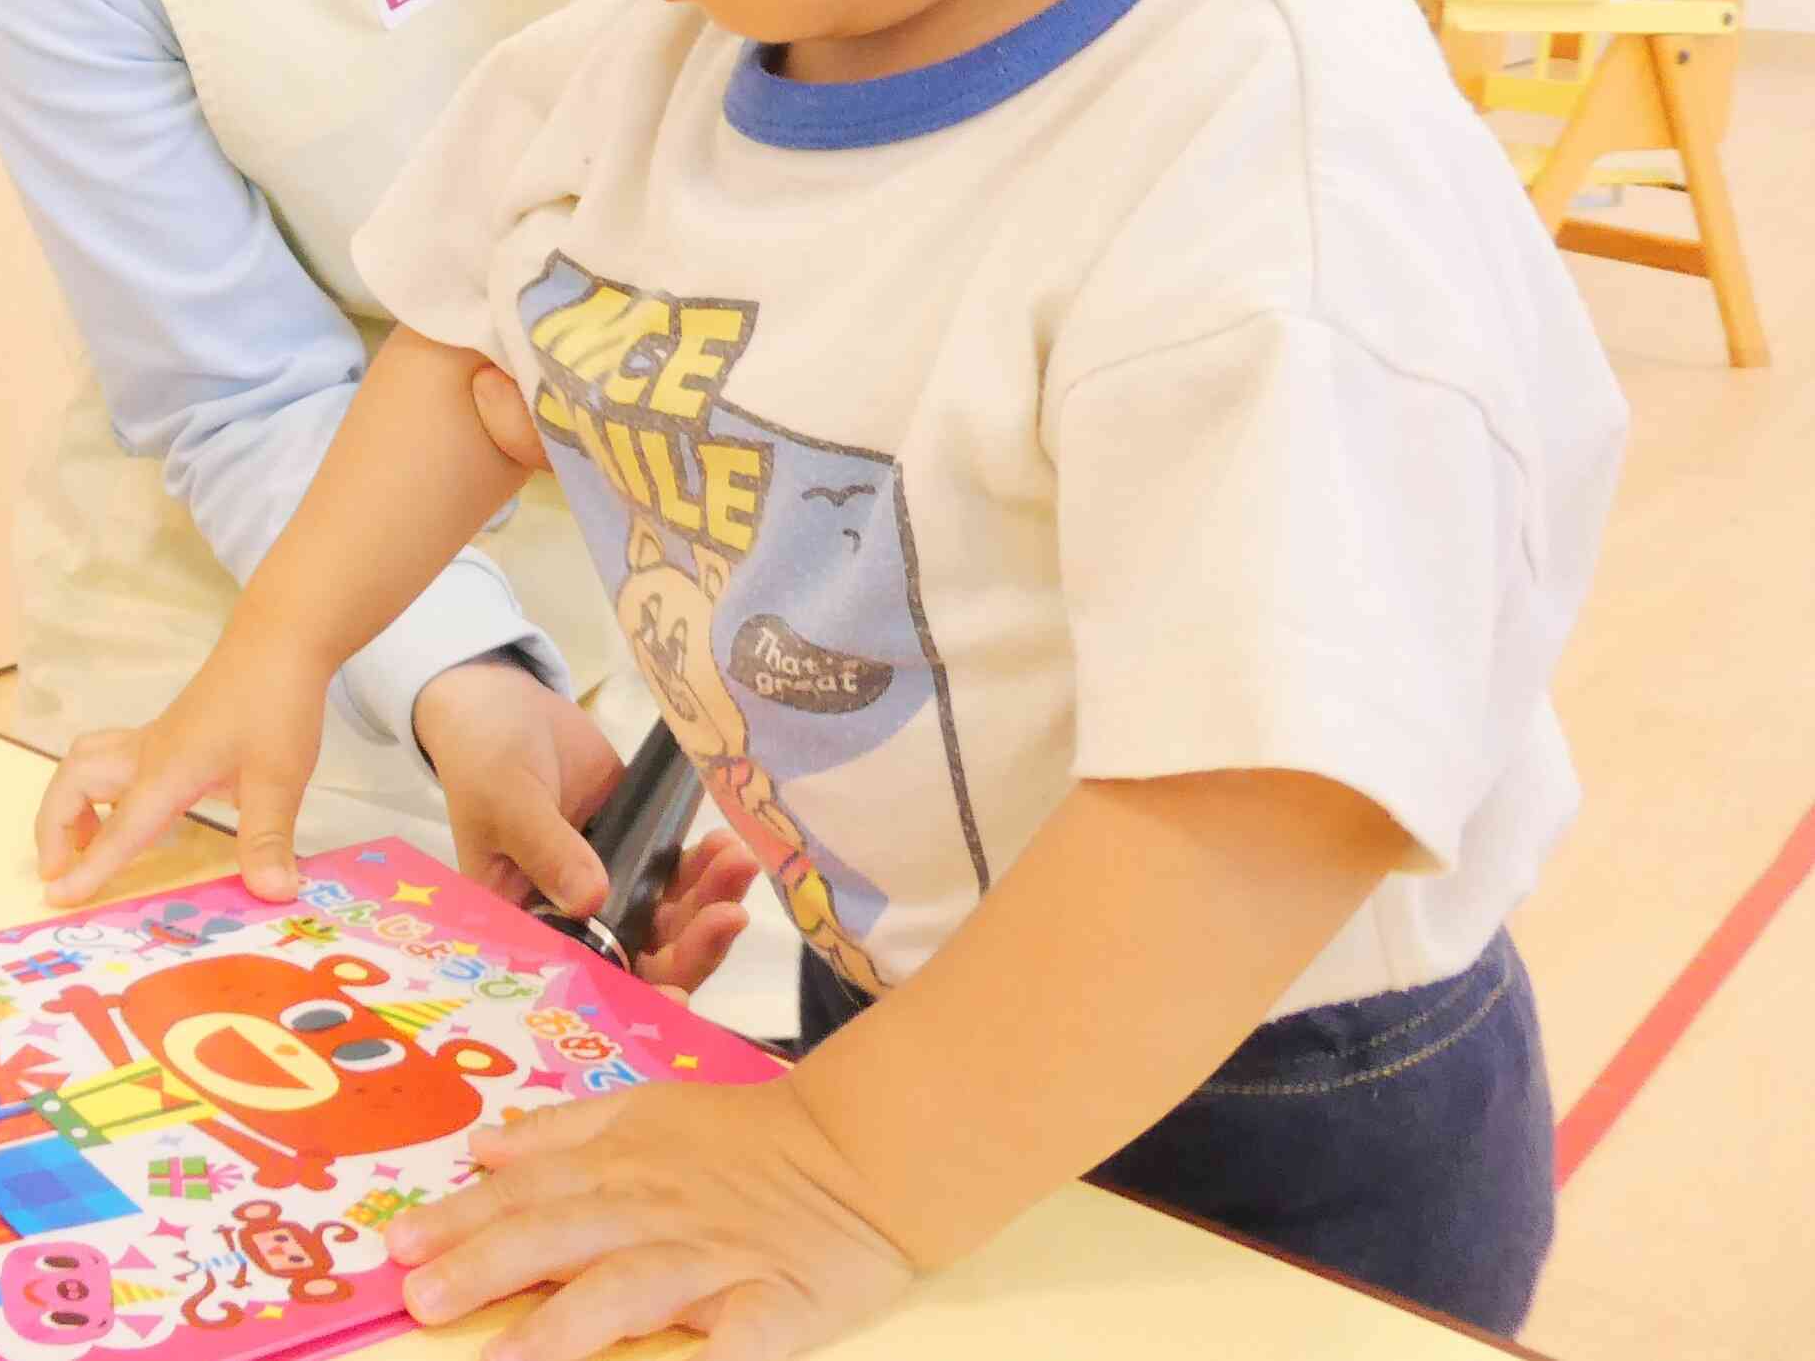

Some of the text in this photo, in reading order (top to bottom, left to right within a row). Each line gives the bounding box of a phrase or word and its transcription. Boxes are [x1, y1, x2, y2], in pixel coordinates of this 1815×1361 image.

[754, 669, 859, 702] great
[298, 878, 545, 1001] たんじょうび
